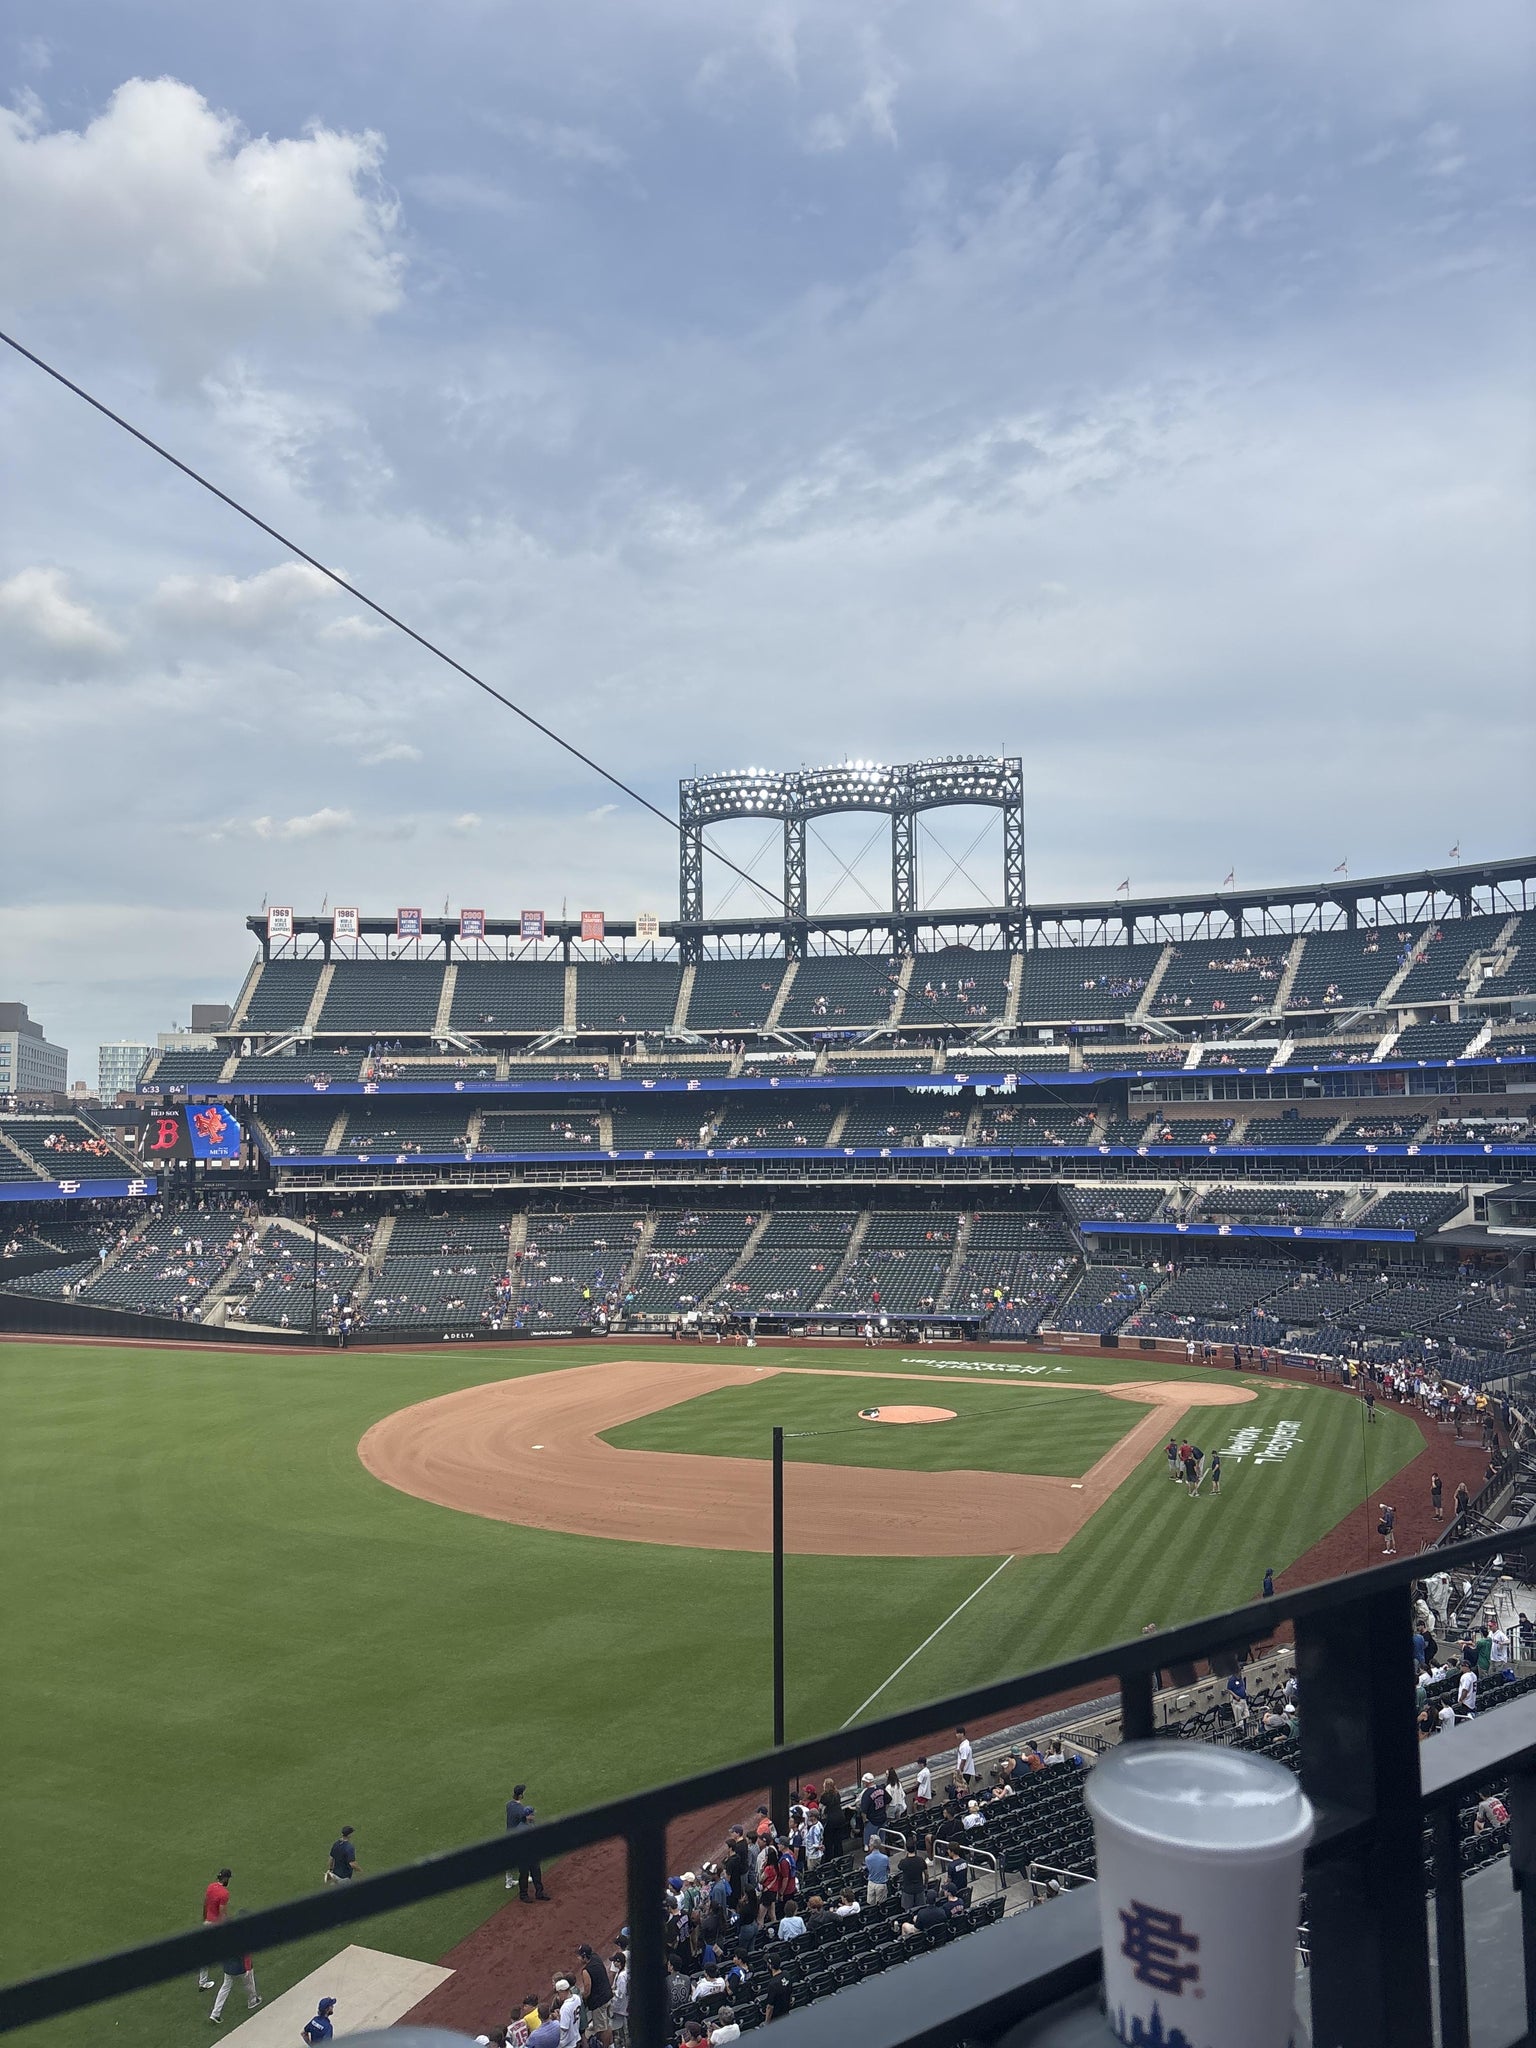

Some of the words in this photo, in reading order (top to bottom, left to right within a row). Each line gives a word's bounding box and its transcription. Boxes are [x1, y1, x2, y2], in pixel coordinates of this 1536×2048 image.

[272, 909, 290, 917] 1969
[338, 910, 355, 918] 1986
[401, 911, 418, 919] 1973
[463, 911, 482, 919] 2000
[524, 912, 541, 921] 2015
[169, 1085, 185, 1093] 84°
[150, 1119, 179, 1150] B
[671, 1986, 688, 2003] 39
[515, 2028, 528, 2047] 15
